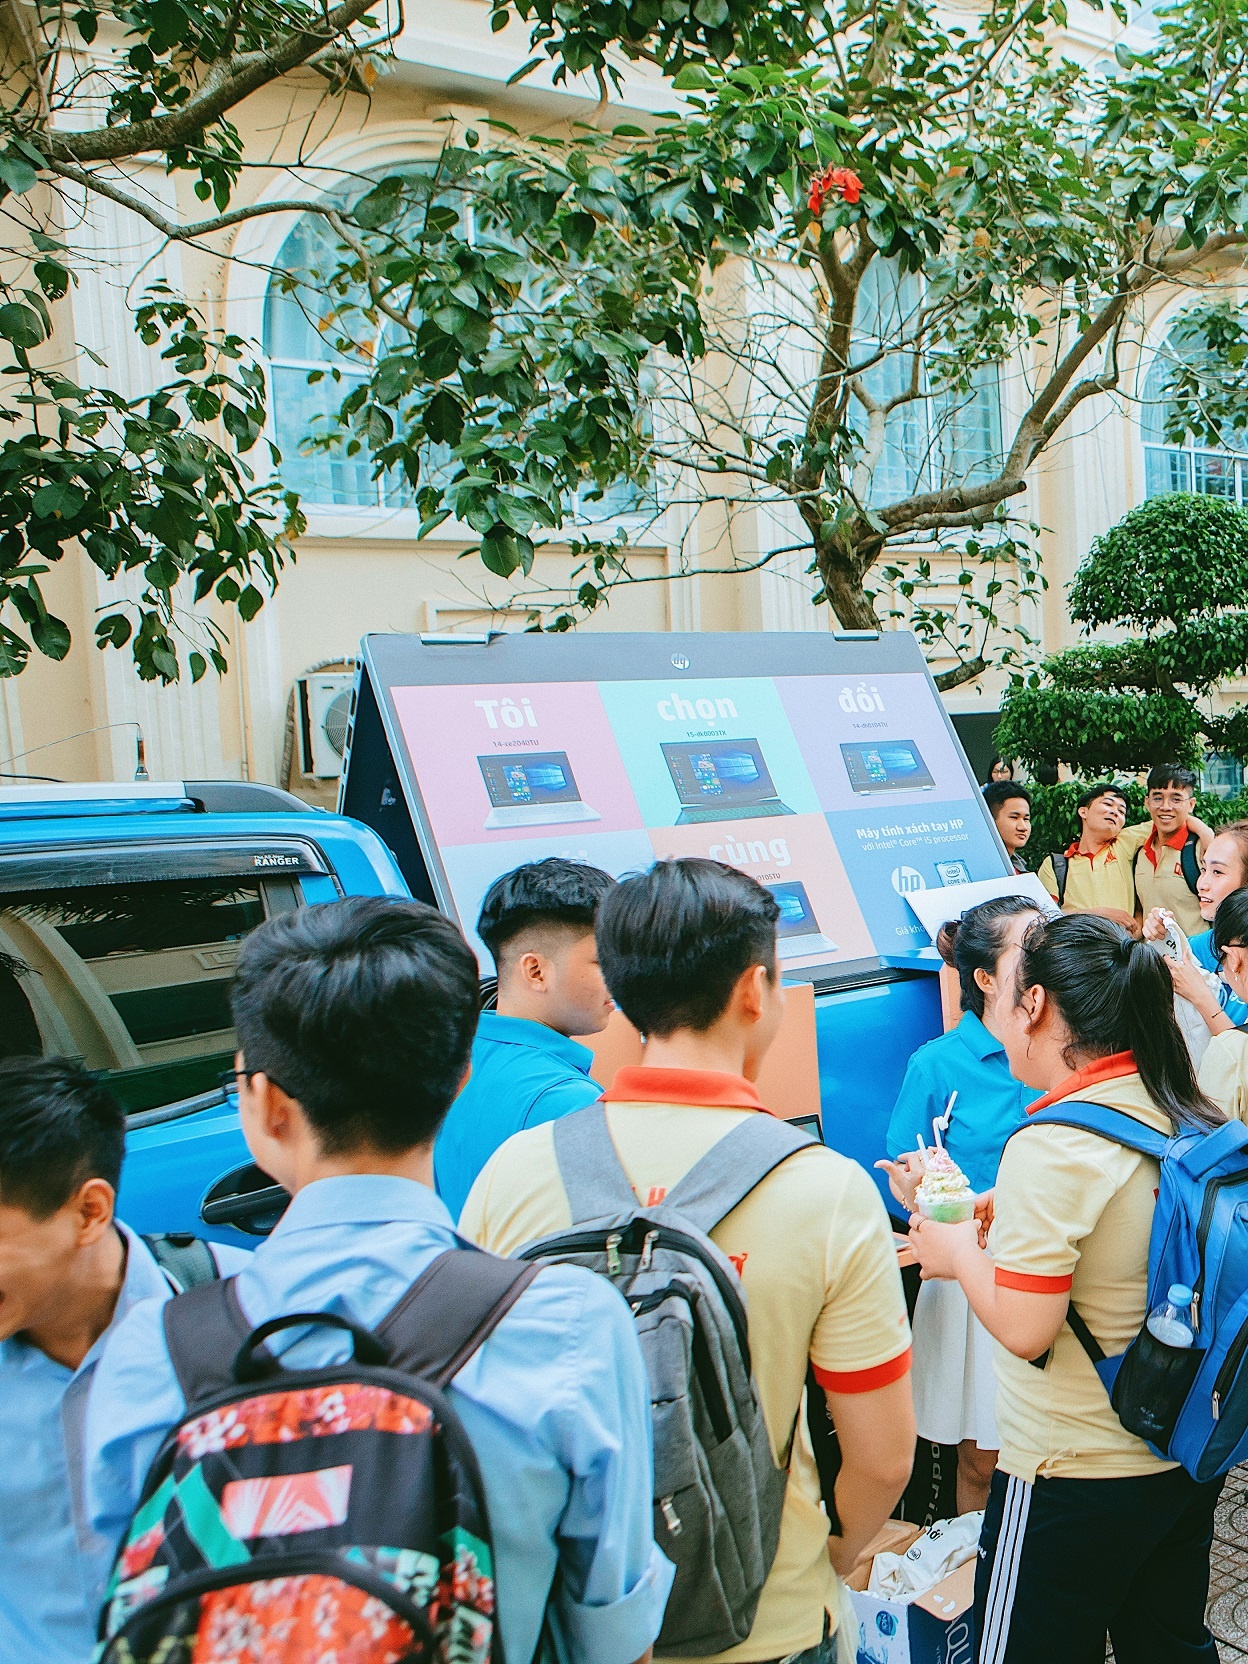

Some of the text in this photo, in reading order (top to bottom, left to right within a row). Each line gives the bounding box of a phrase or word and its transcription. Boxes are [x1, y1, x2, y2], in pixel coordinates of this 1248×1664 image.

[838, 682, 886, 713] đổi
[474, 697, 538, 729] Tôi
[657, 692, 739, 727] chọn
[856, 819, 964, 839] Máy tính xách tay HP
[933, 833, 969, 845] processor
[254, 857, 299, 866] RANGER
[708, 835, 792, 868] cùng
[947, 867, 960, 877] intel
[895, 926, 909, 936] Giá
